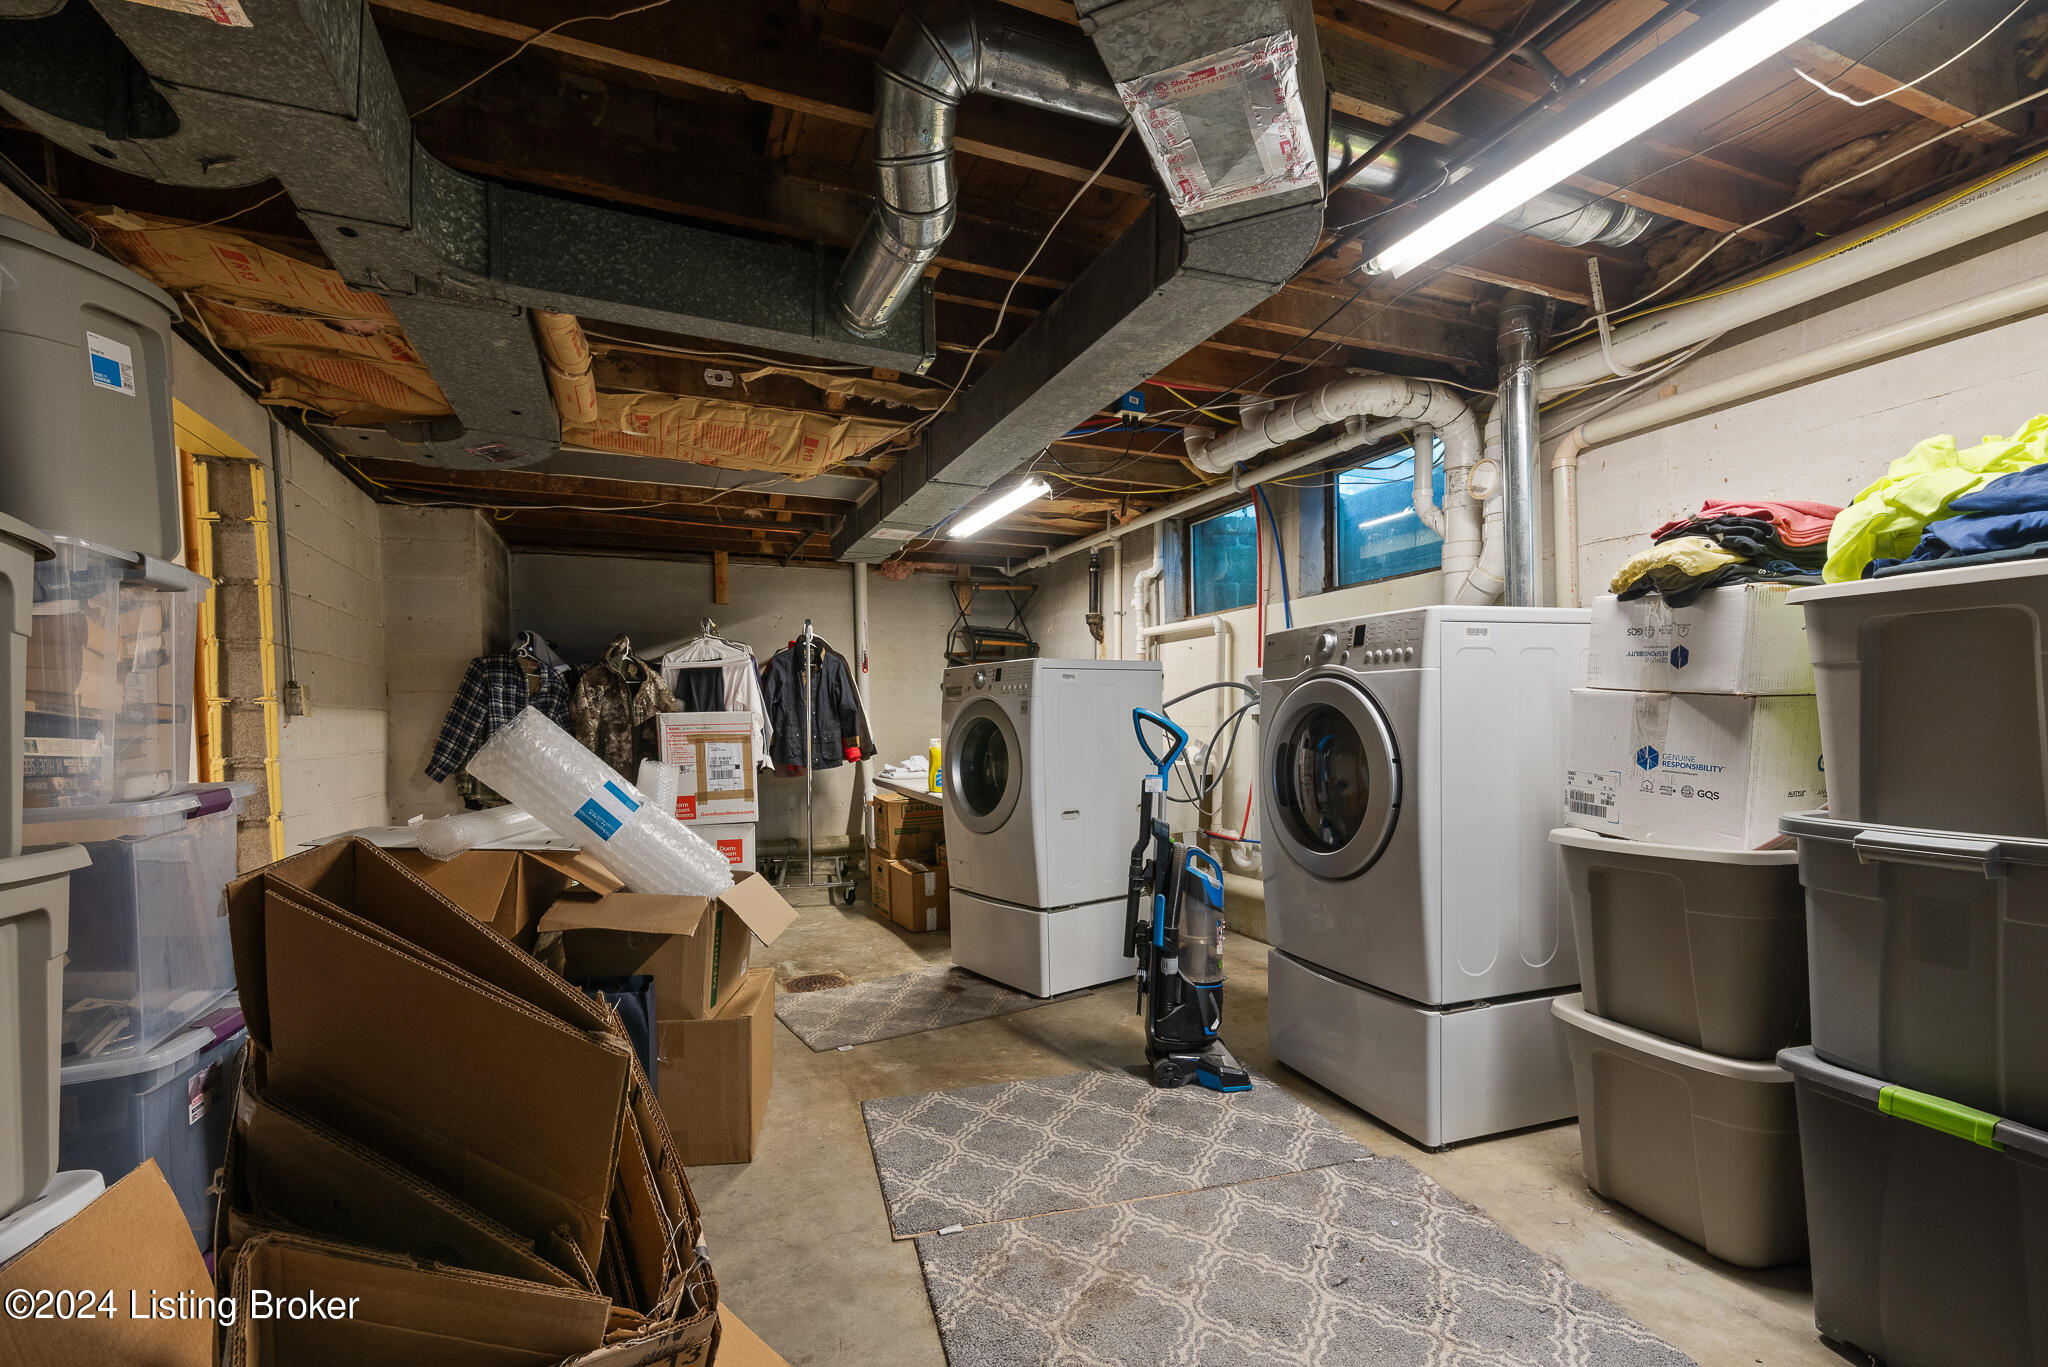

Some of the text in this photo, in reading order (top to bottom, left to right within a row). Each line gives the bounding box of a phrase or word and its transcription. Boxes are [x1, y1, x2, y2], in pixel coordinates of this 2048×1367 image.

[1171, 61, 1245, 87] Shurtape AF 100
[1959, 196, 1976, 207] SCH
[1976, 191, 1988, 199] 40
[803, 448, 815, 462] R-13
[1662, 753, 1696, 762] GENUINE
[1661, 761, 1724, 773] RESPONSIBILITY
[1697, 790, 1720, 801] GQS
